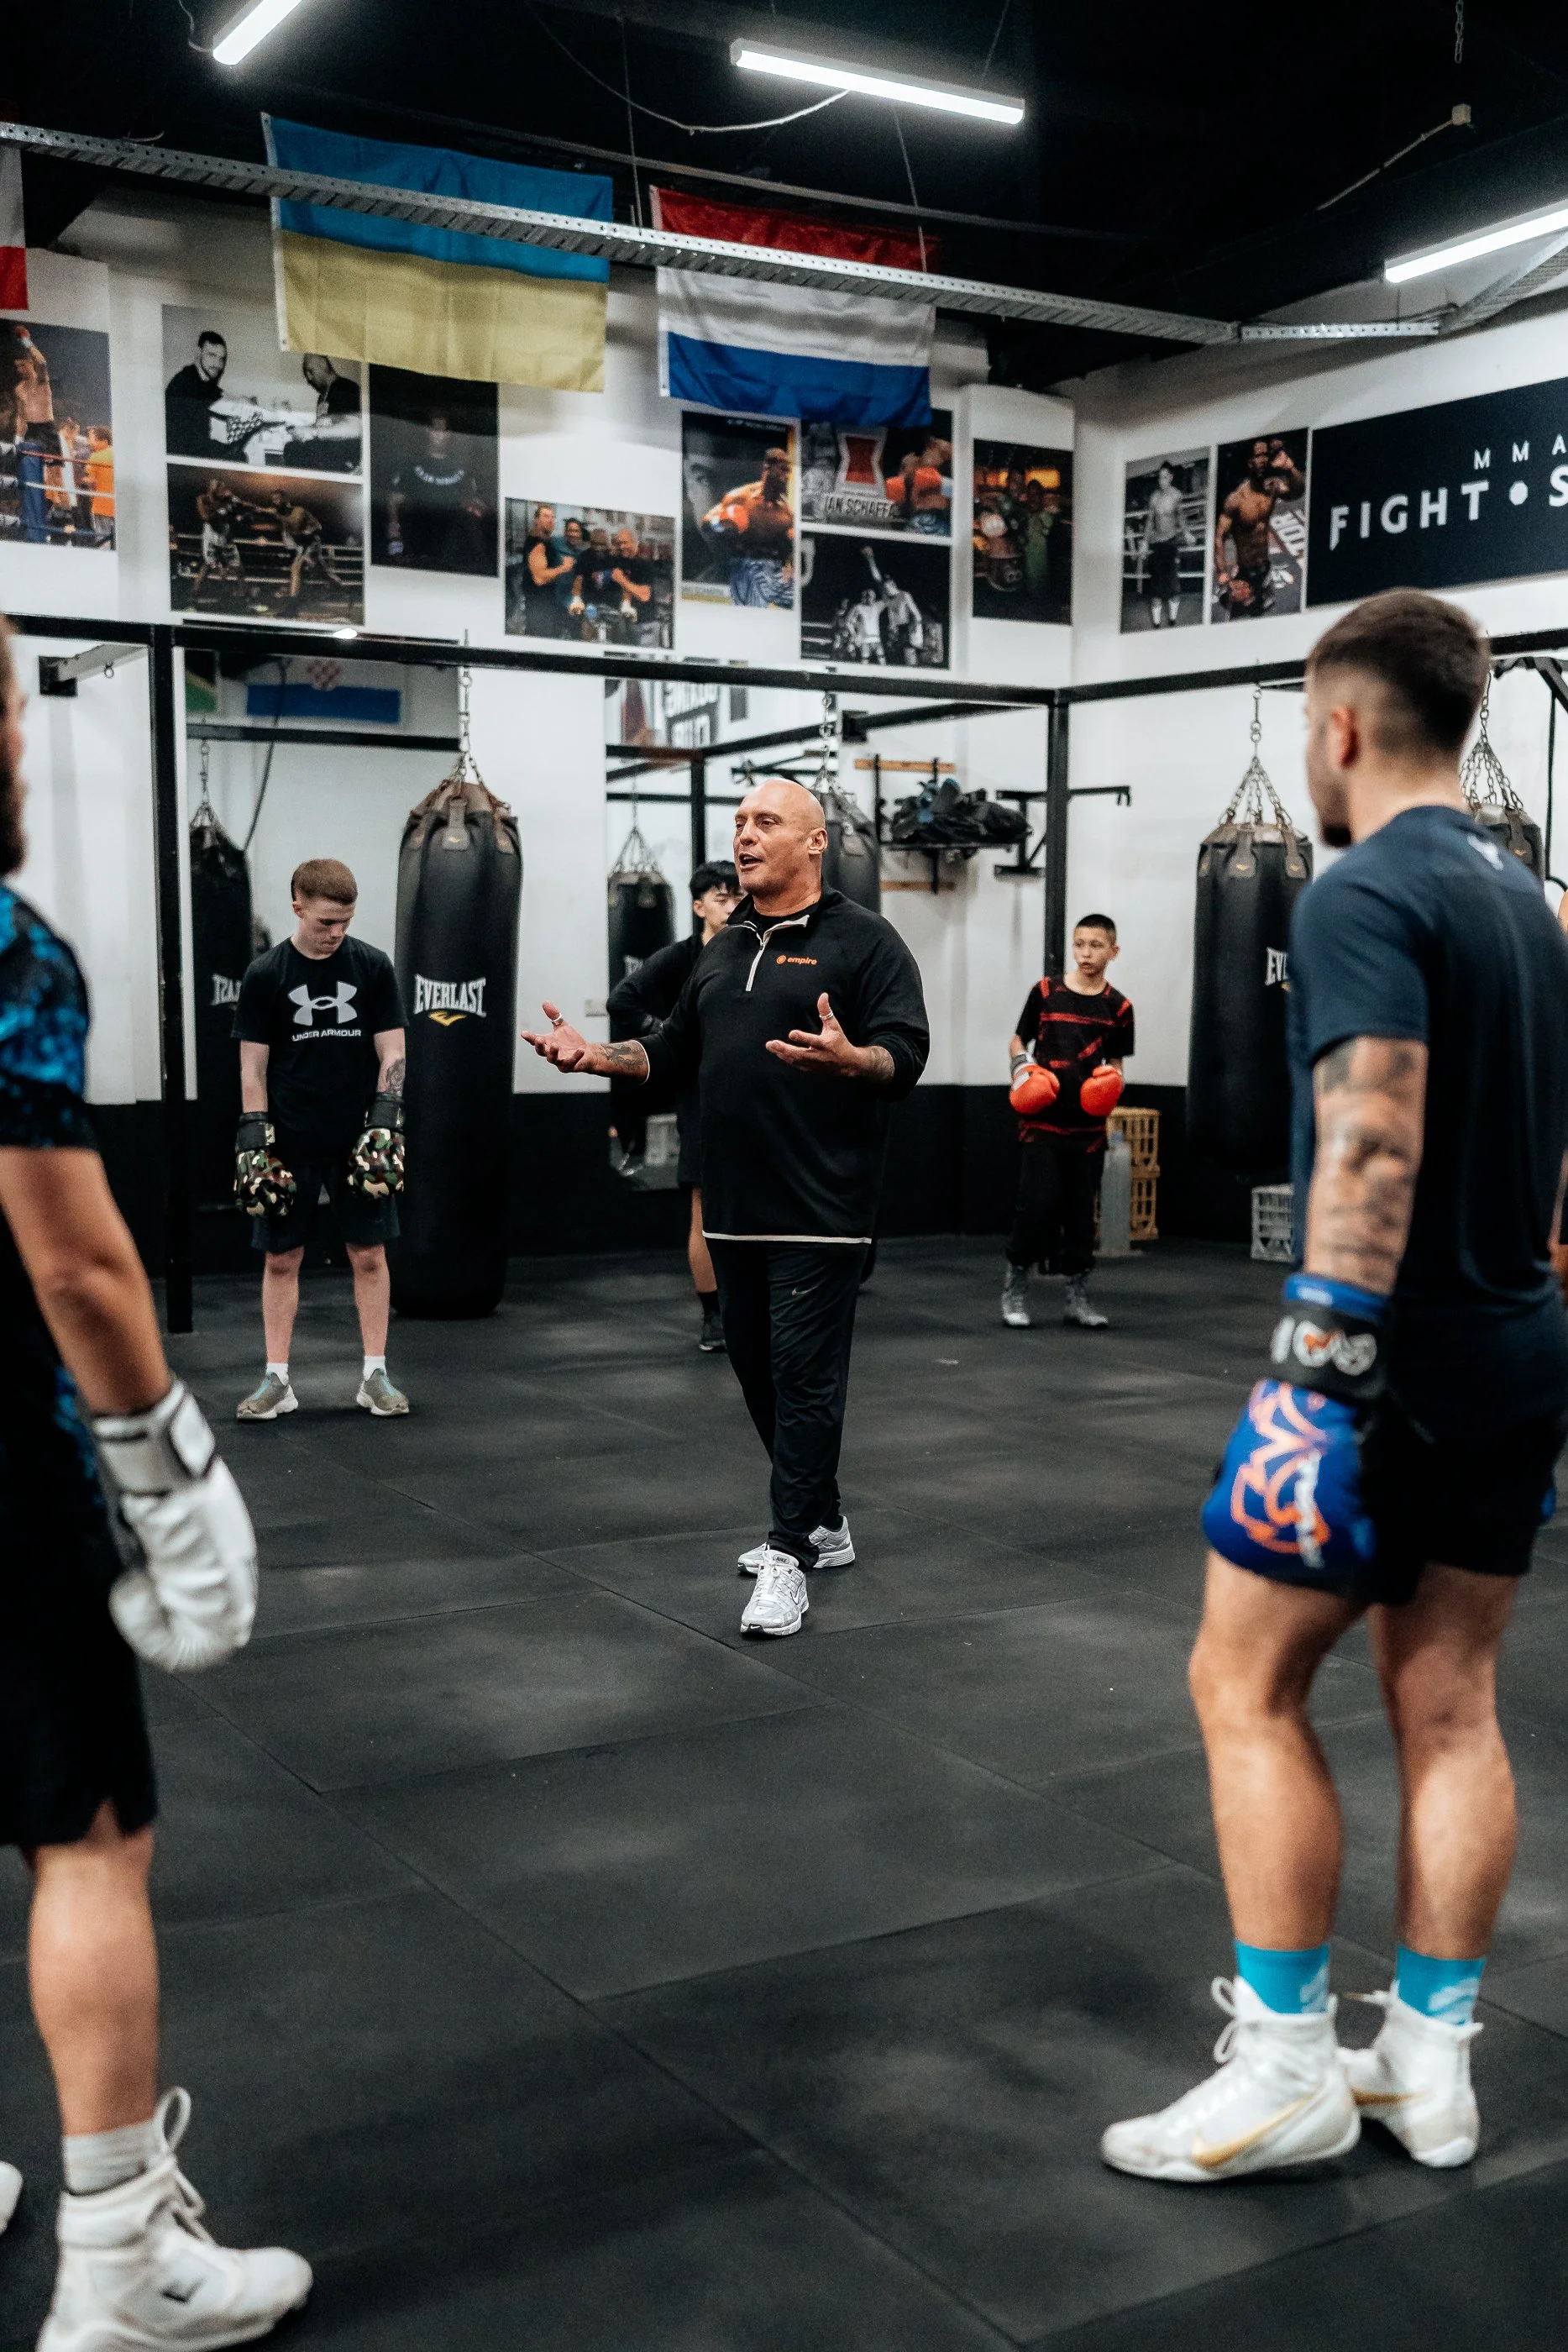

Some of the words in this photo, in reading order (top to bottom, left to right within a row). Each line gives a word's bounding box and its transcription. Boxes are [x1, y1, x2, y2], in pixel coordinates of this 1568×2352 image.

[1329, 479, 1489, 552] FIGHT
[413, 974, 486, 1018] EVERLAST
[292, 1031, 319, 1042] UNDER
[320, 1029, 361, 1037] ARMOUR
